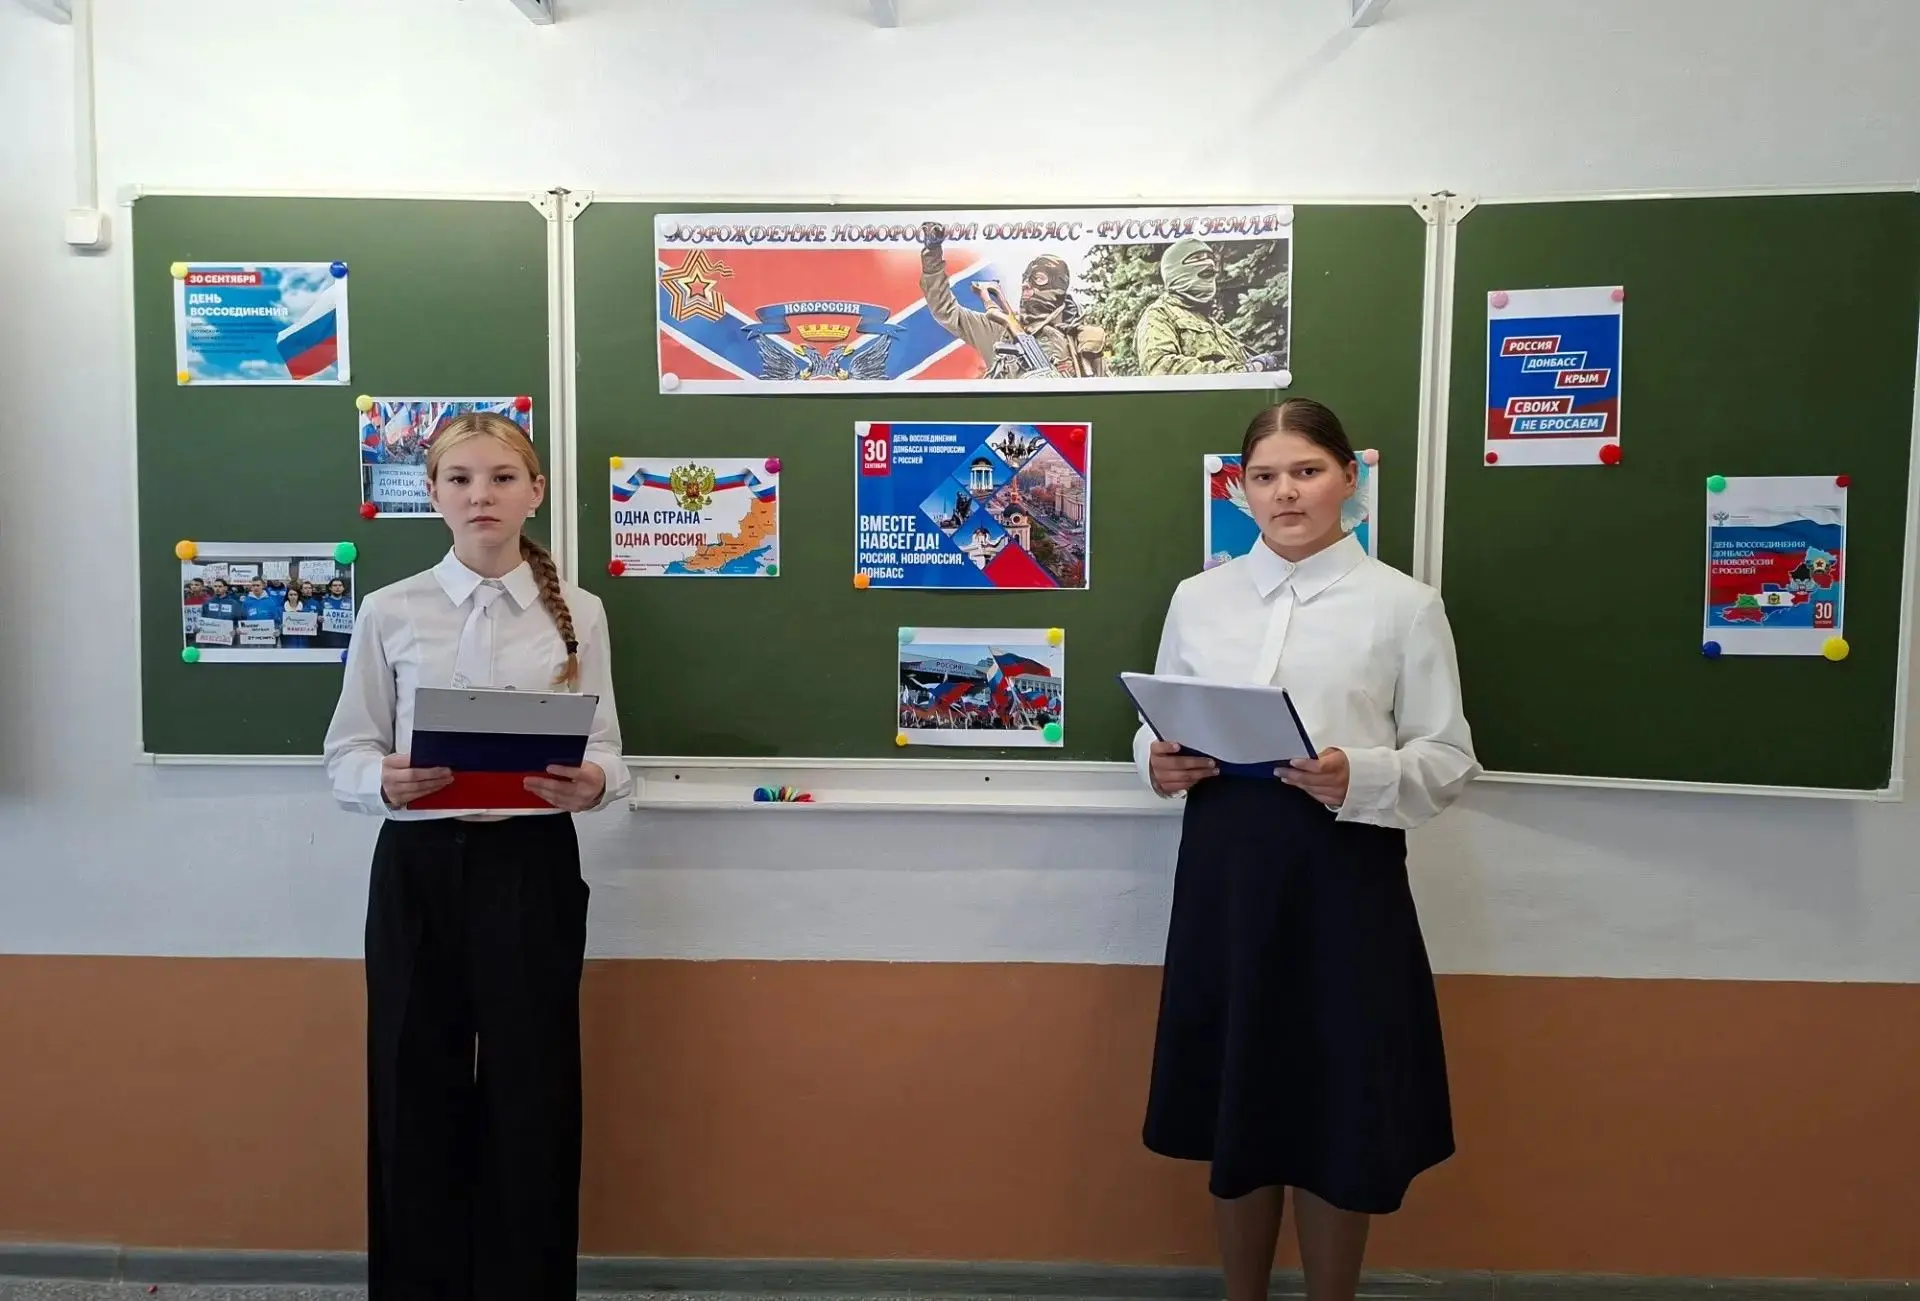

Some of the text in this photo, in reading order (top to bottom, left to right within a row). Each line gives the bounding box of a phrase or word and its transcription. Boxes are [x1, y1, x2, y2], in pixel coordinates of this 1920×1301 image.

[982, 220, 1083, 241] ДОНБАСС
[1096, 216, 1200, 240] РУССКАЯ
[190, 274, 256, 284] 30 СЕНТЯБРЯ
[189, 293, 222, 305] ДЕНЬ
[190, 306, 289, 317] ВОССОЕДИНЕНИЯ
[784, 302, 860, 314] НОВОРОССИЯ
[1509, 340, 1553, 352] РОССИЯ
[1527, 357, 1578, 369] ДОНБАСС
[1564, 373, 1599, 384] КРЫМ
[1514, 401, 1561, 413] СВОИХ
[1520, 418, 1599, 430] НЕ БРОСАЕМ
[893, 434, 909, 443] ДЕНЬ
[864, 439, 887, 462] 30
[893, 445, 923, 454] ДОНБАССА
[615, 511, 650, 525] ОДНА
[653, 510, 700, 524] СТРАНА
[860, 515, 917, 532] ВМЕСТЕ
[615, 533, 707, 547] ОДНА РОССИЯ!
[860, 532, 940, 552] НАВСЕГДА!
[1712, 540, 1806, 549] ДЕНЬ ВОССОЕДИНЕНИЯ
[860, 552, 965, 566] РОССИЯ, НОВОРОССИЯ,
[1712, 549, 1755, 558] ДОНБАССА
[1719, 566, 1756, 575] РОССИЕЙ
[1815, 602, 1833, 619] 30
